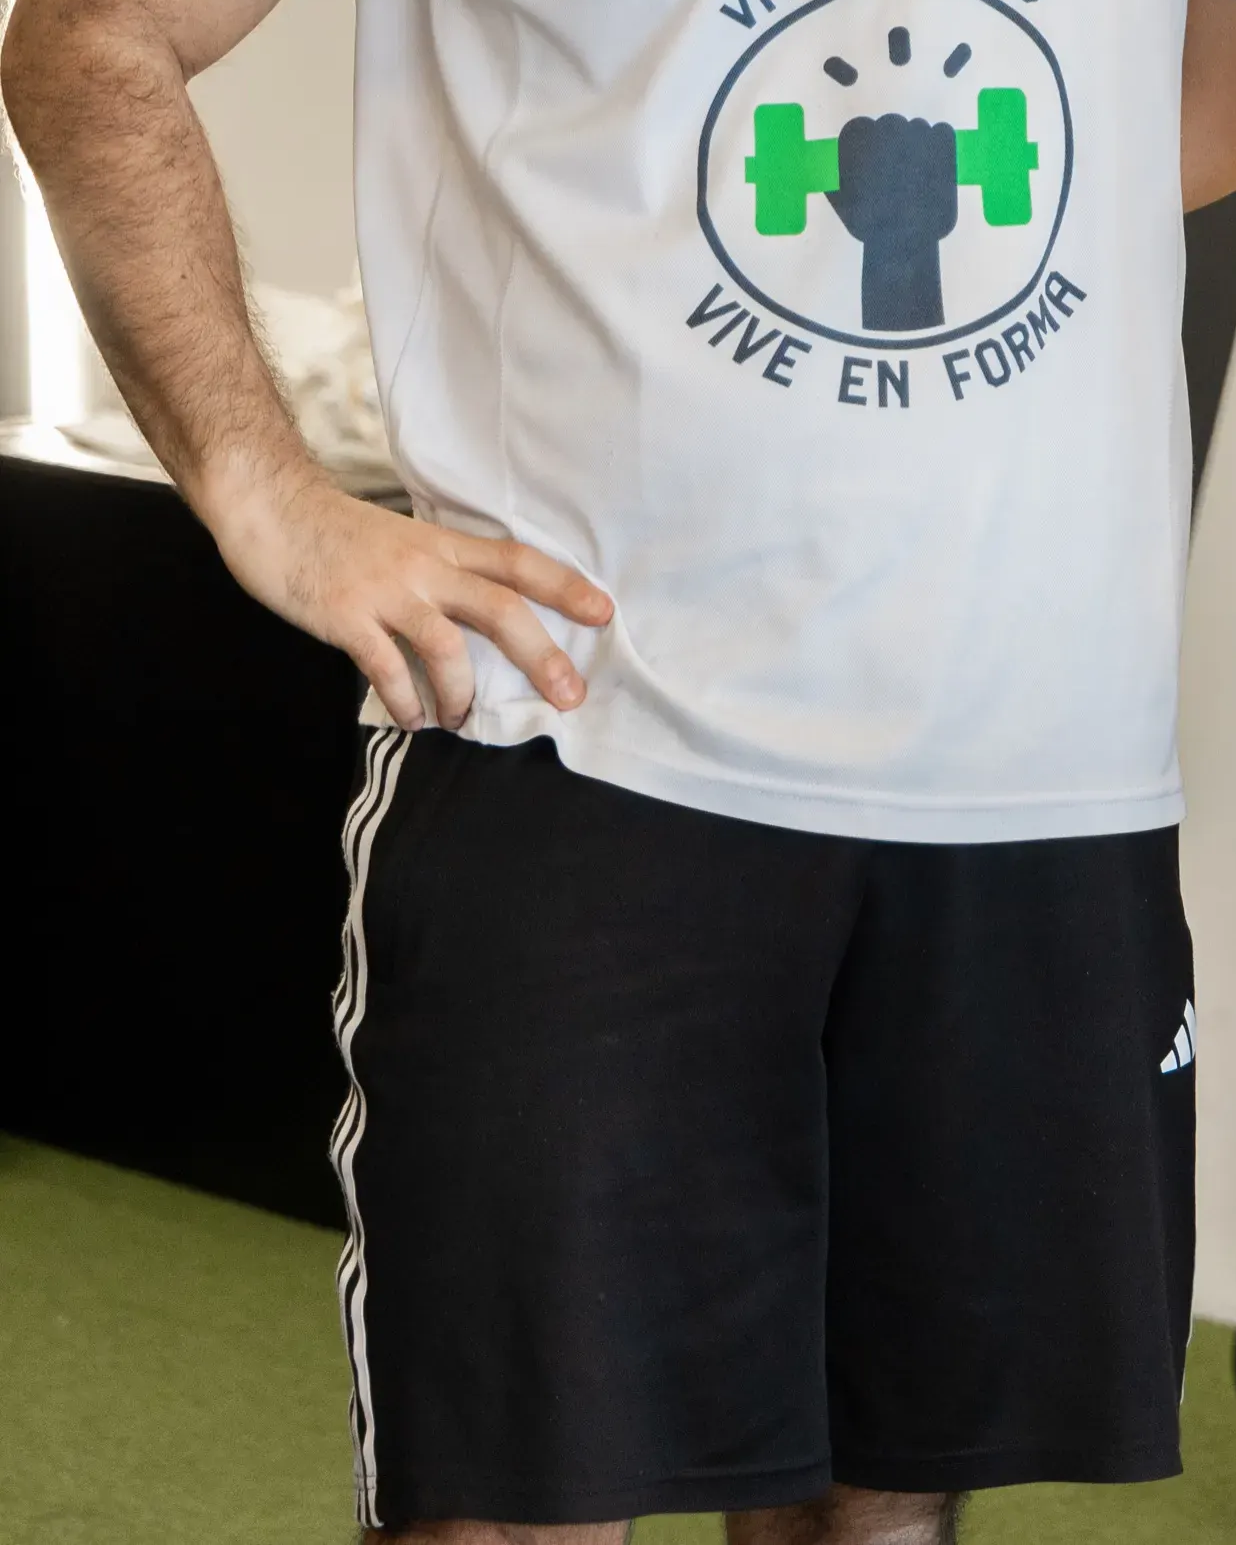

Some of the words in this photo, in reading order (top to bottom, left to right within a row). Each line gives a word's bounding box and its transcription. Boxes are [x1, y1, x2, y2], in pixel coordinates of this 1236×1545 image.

[684, 283, 813, 389] VIVE
[837, 356, 910, 409] EN
[942, 270, 1088, 402] FORMA
